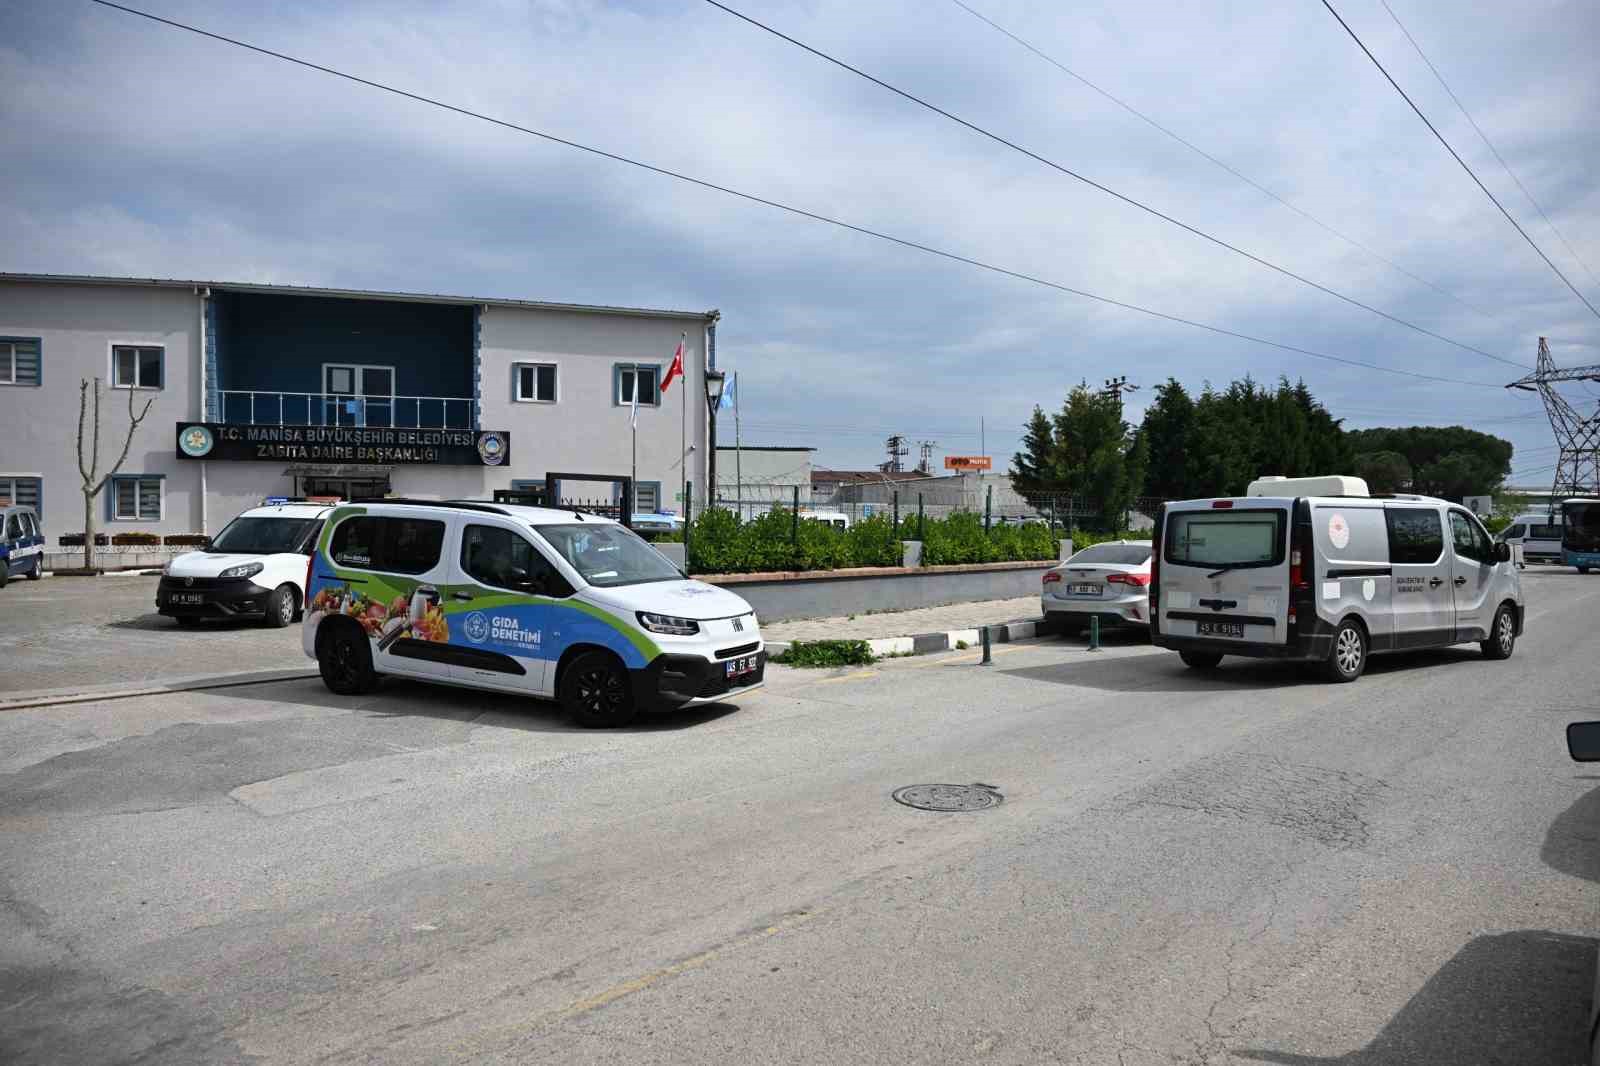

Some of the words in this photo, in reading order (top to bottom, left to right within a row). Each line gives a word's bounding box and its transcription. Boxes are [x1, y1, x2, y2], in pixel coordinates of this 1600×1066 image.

[217, 427, 243, 440] T.C.
[248, 425, 303, 441] MANİSA
[306, 426, 394, 445] BÜYÜKŞEHİR
[400, 431, 474, 446] BELEDİYESİ
[257, 444, 307, 458] ZABITA
[312, 443, 353, 459] DAİRE
[357, 446, 438, 462] BAŞKANLIĞI
[492, 616, 518, 629] GIDA
[491, 628, 541, 644] DENETİMİ
